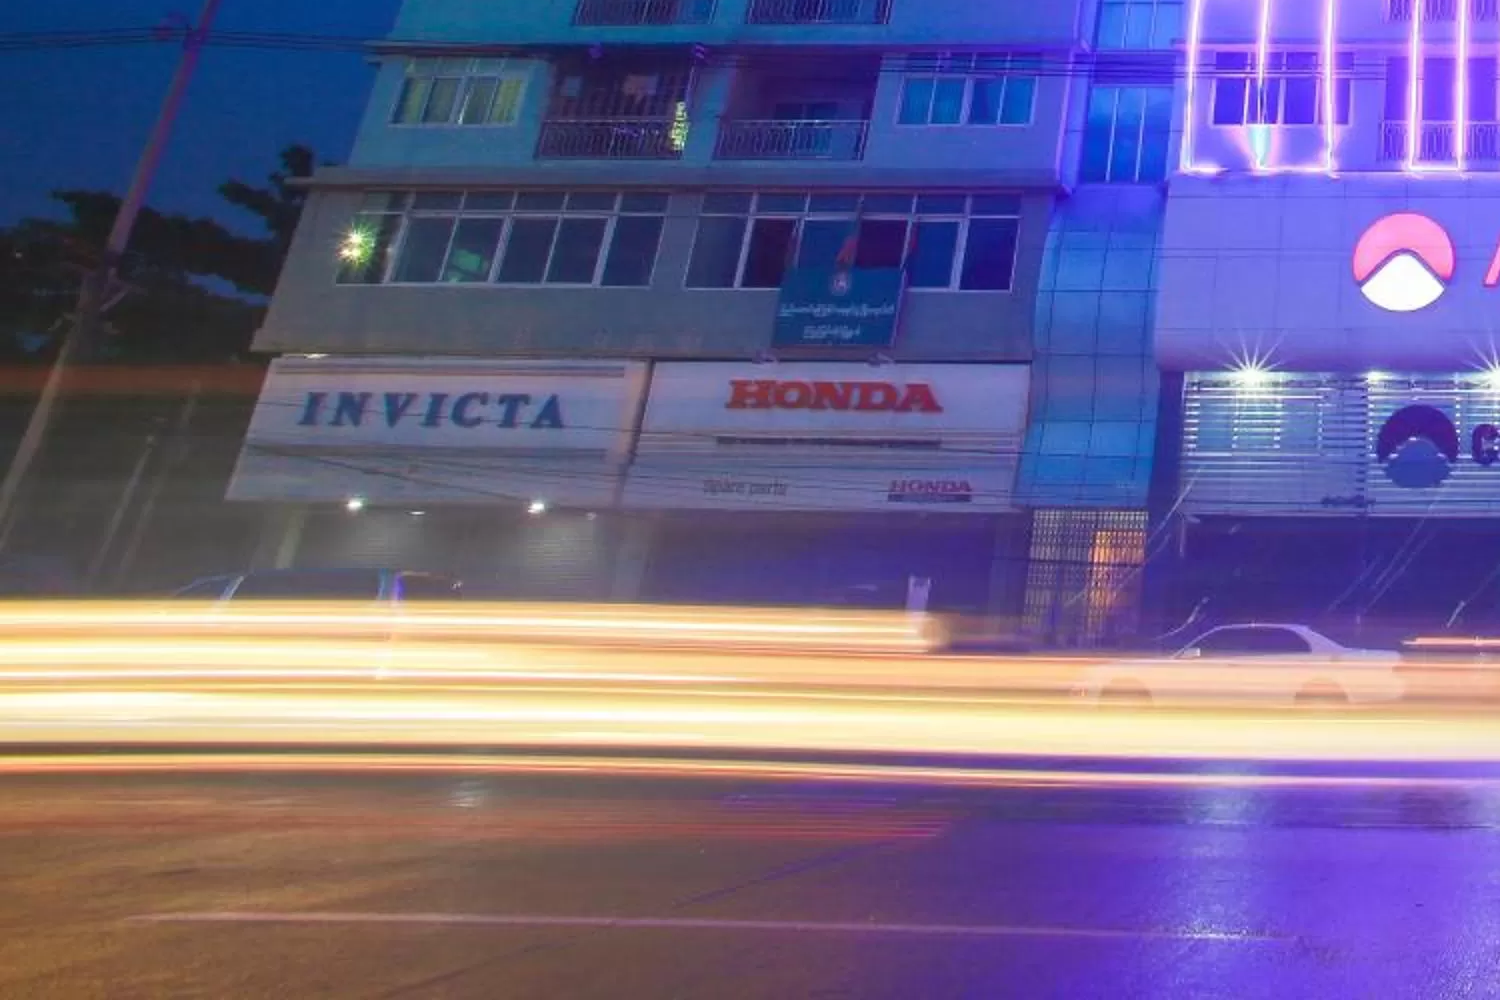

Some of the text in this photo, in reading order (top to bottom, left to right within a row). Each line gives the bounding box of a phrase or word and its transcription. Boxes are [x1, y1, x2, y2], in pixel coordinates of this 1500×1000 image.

[299, 391, 564, 429] INVICTA
[725, 380, 944, 413] HONDA
[889, 480, 972, 492] HONDA
